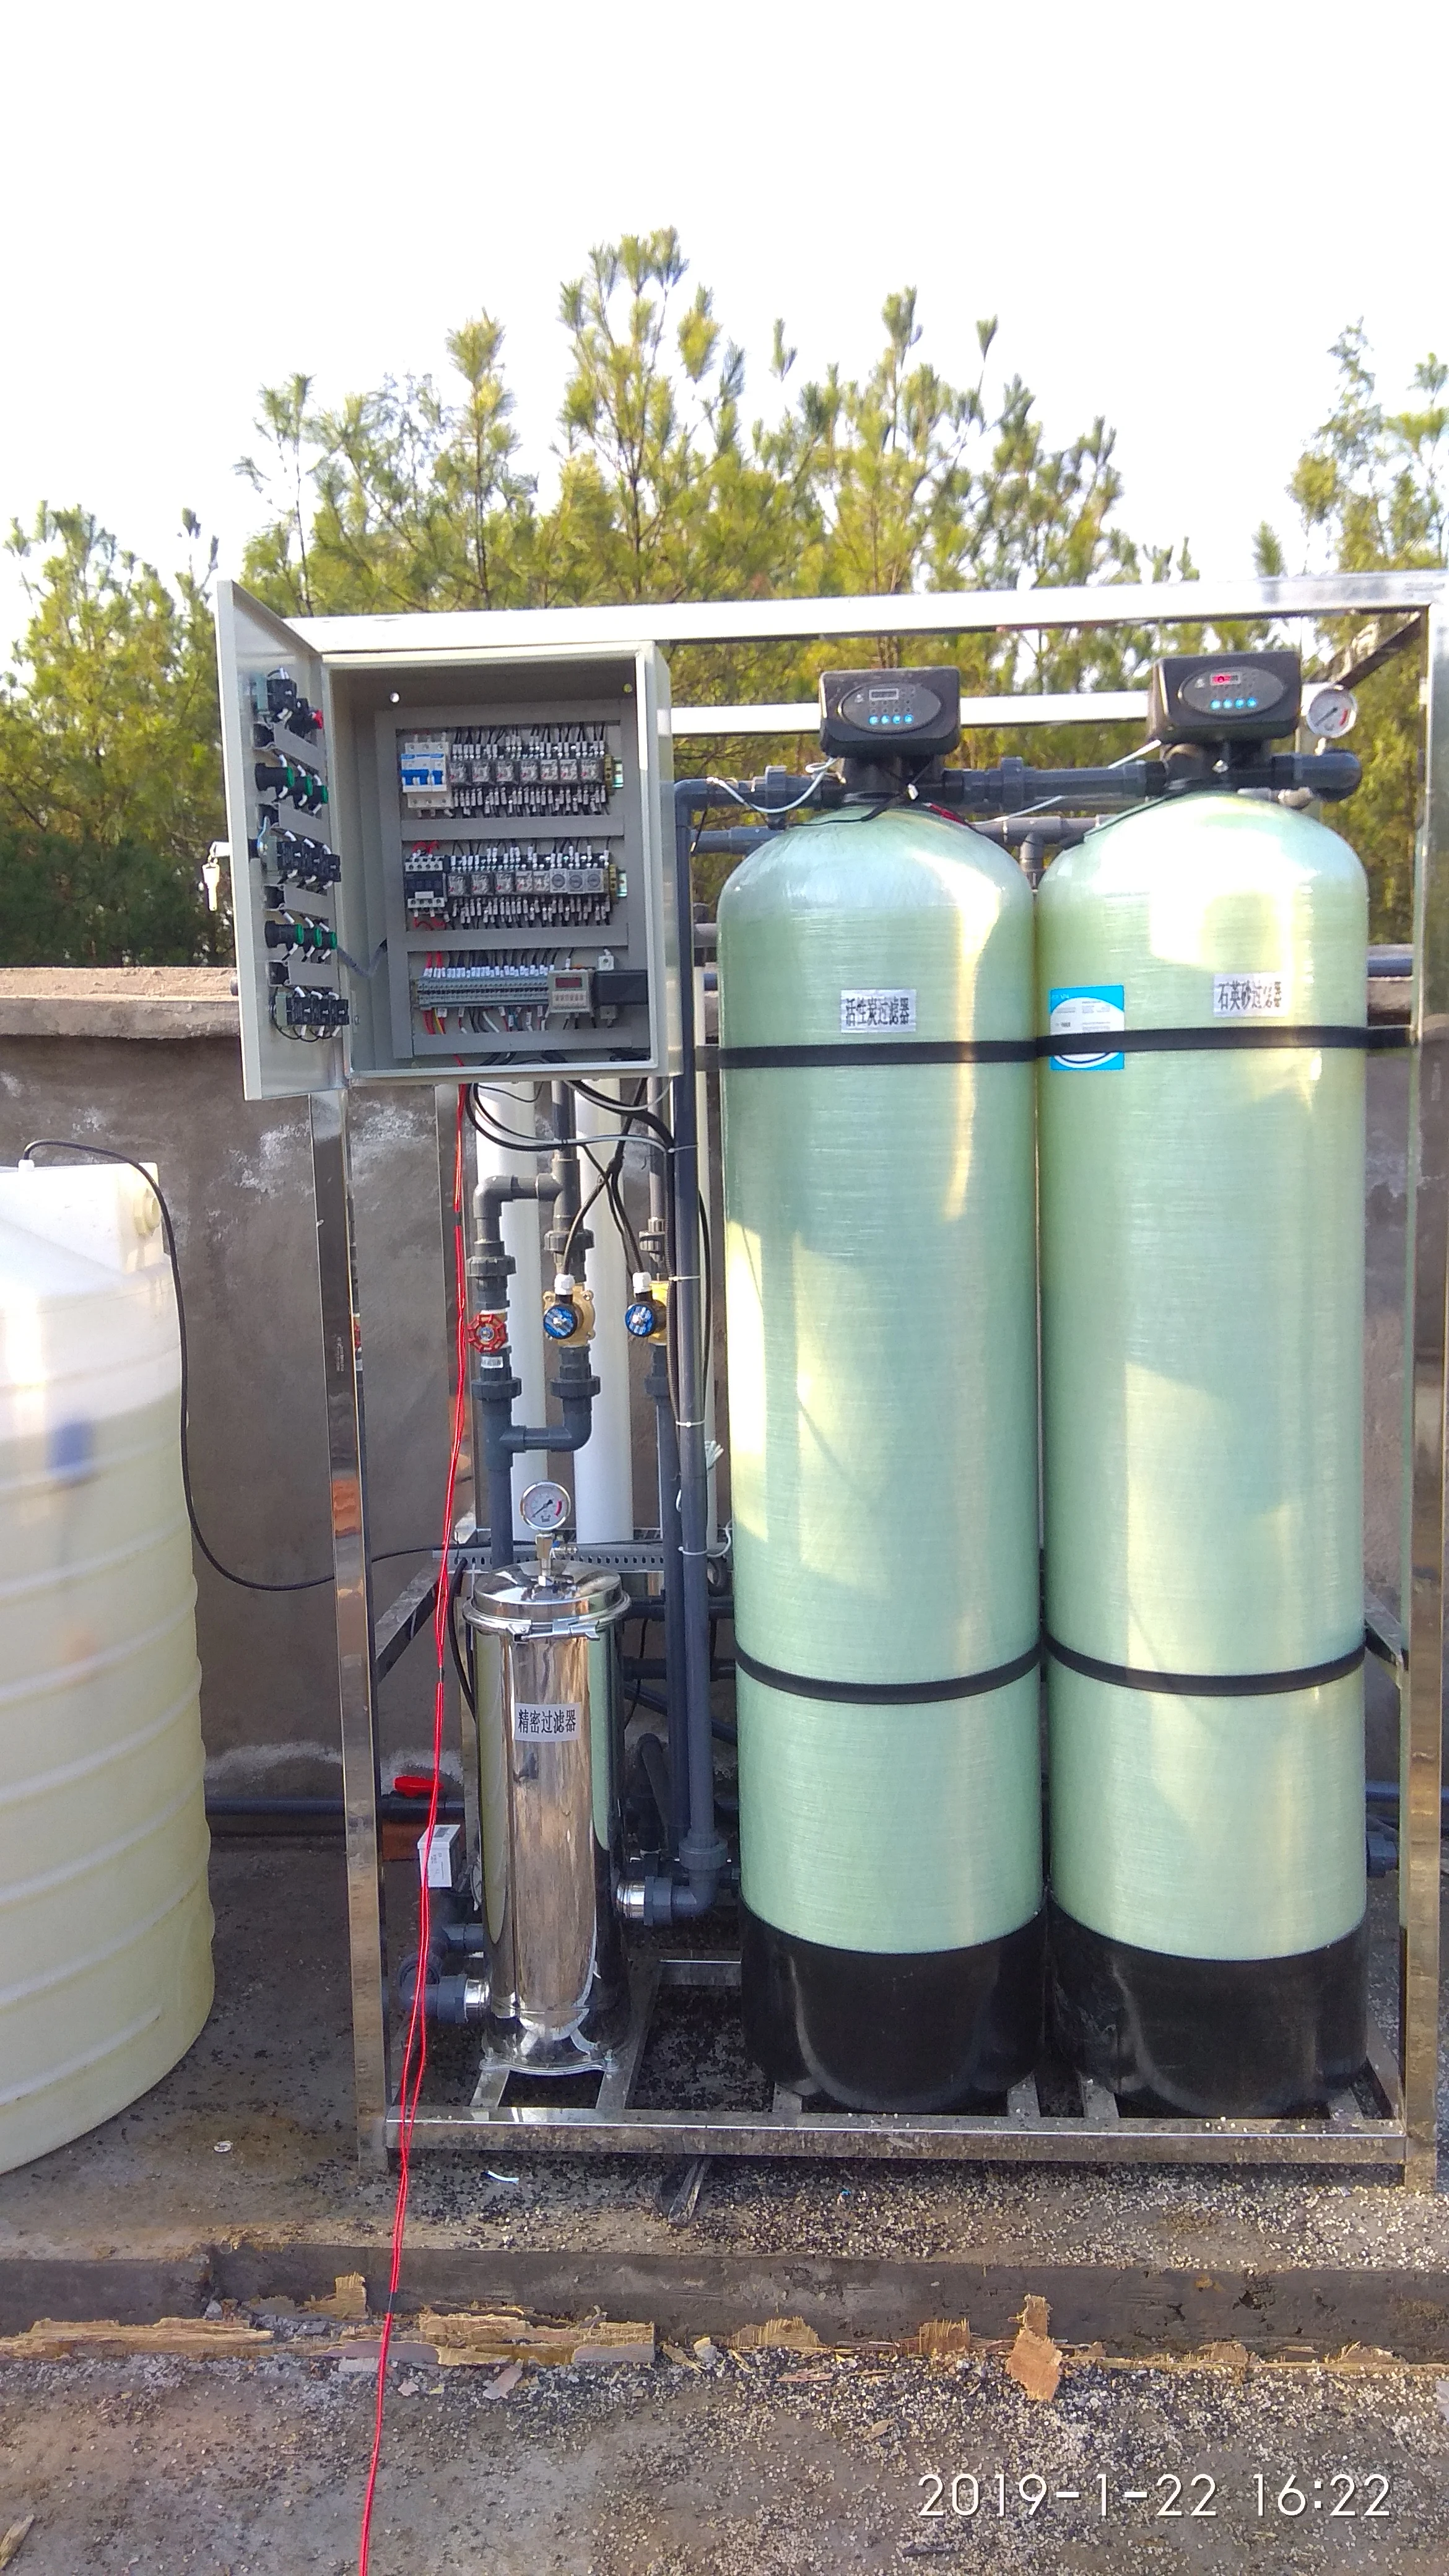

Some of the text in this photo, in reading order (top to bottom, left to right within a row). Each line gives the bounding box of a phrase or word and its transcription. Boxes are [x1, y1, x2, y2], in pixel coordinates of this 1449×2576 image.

[845, 996, 910, 1026] 活性炭过滤器
[518, 1709, 577, 1734] 精密过滤器
